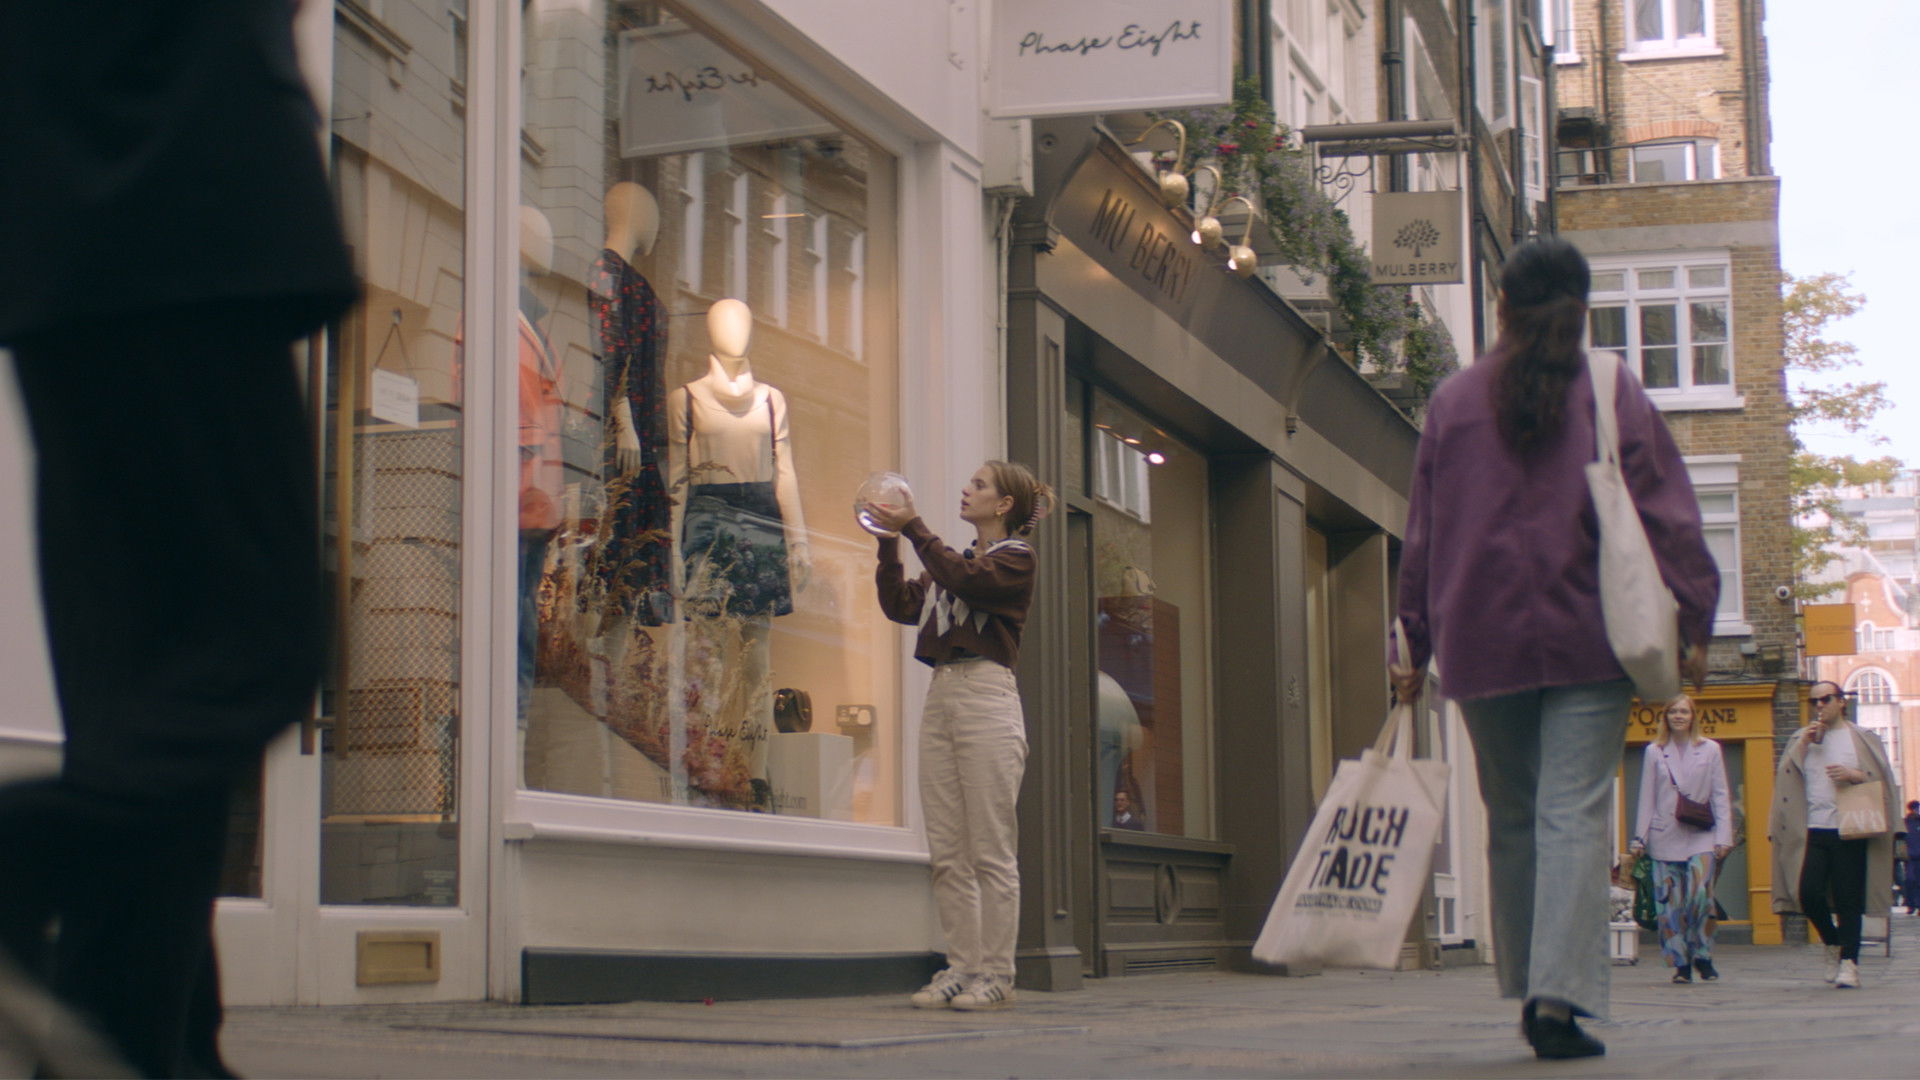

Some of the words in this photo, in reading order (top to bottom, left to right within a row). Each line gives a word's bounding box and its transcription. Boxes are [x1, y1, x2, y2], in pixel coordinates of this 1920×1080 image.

[1019, 31, 1112, 57] Phase
[1117, 20, 1201, 56] Eight
[1375, 262, 1458, 277] MULBERRY
